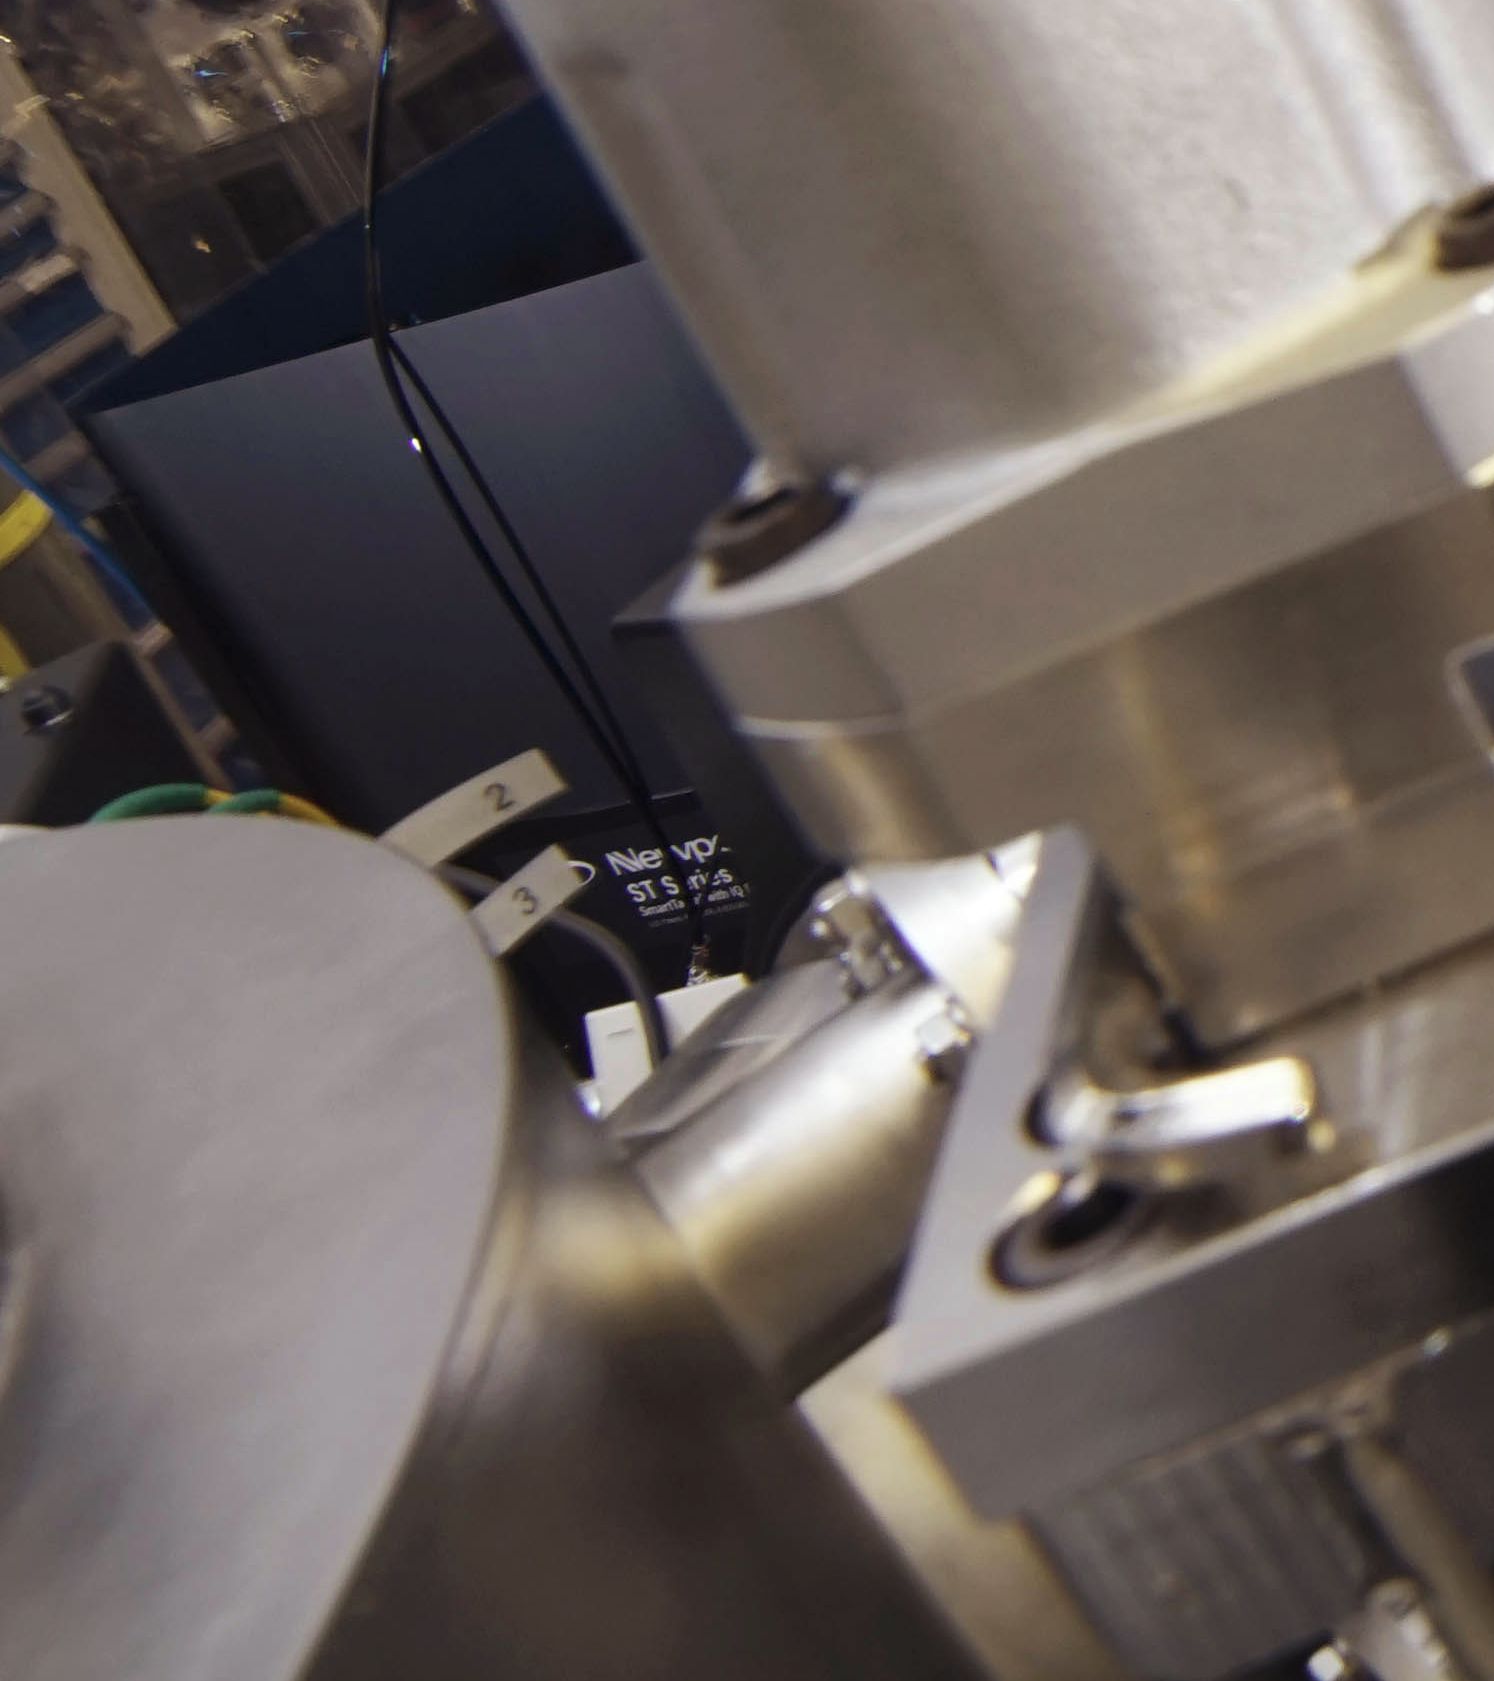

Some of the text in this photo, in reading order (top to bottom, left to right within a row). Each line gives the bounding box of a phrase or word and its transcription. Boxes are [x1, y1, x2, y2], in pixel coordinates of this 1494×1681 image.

[482, 783, 515, 812] 2
[511, 885, 540, 916] 3
[627, 880, 656, 902] ST
